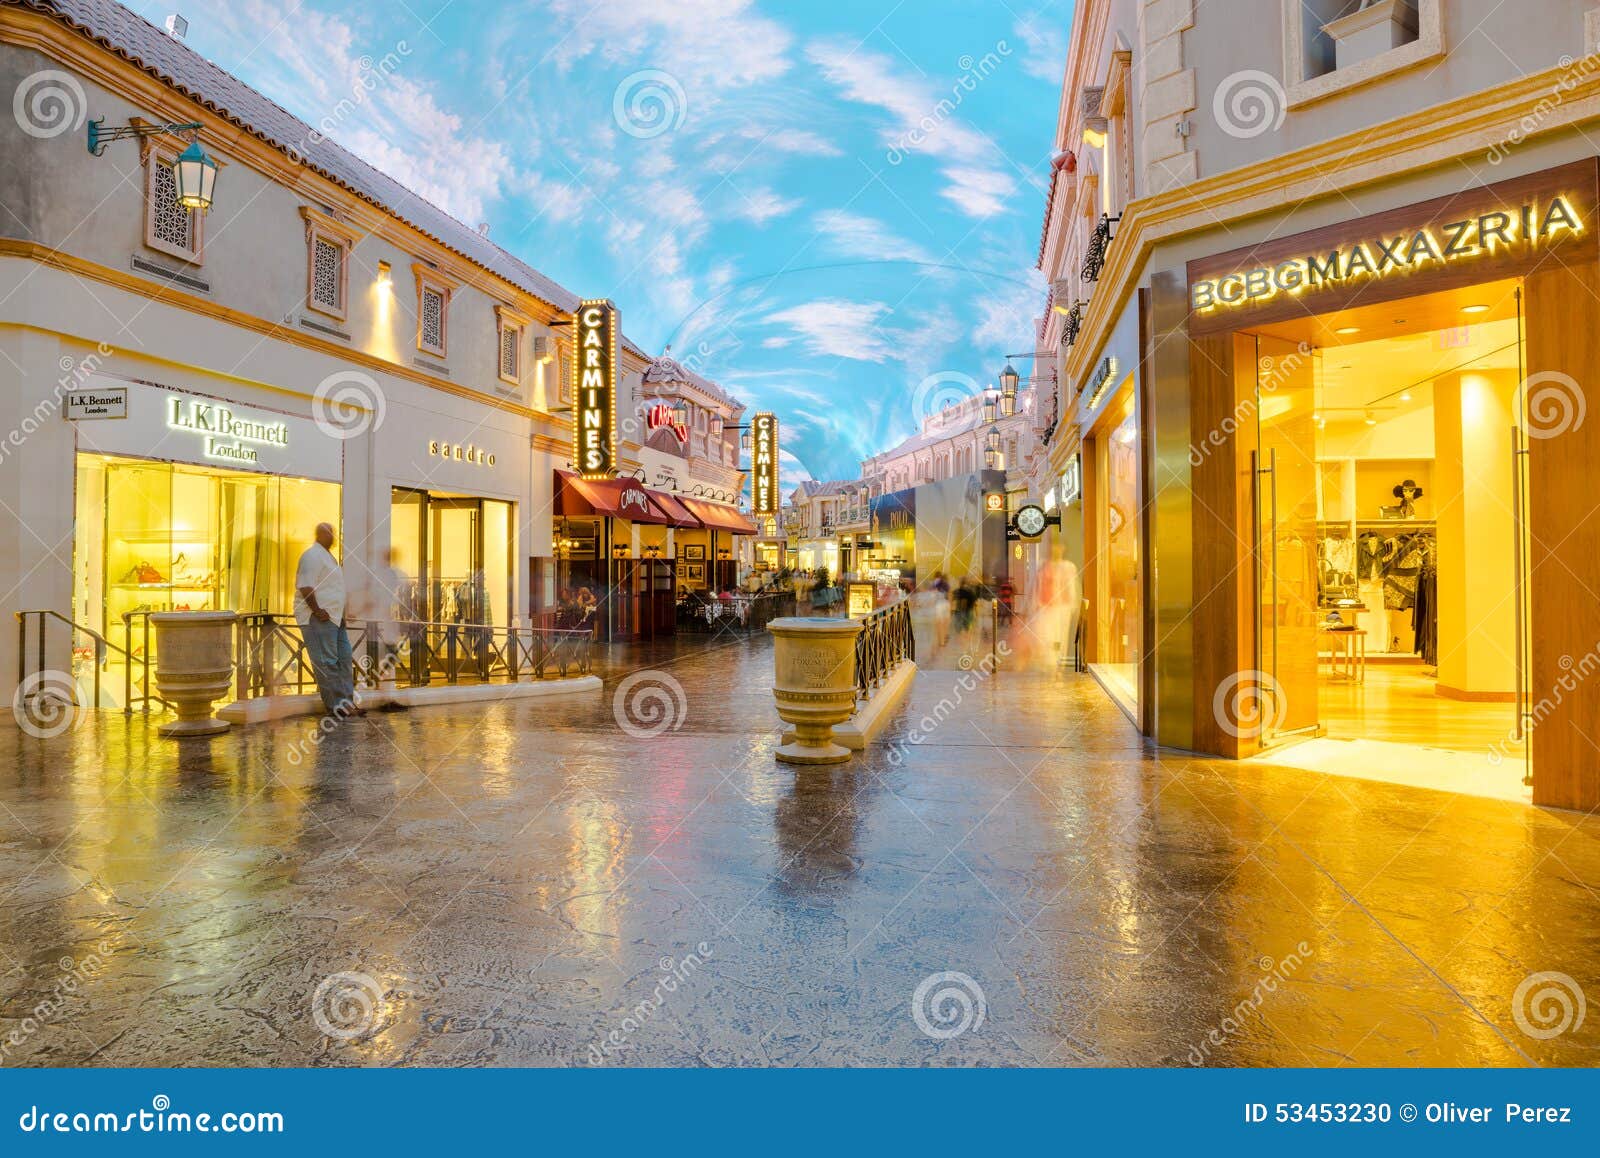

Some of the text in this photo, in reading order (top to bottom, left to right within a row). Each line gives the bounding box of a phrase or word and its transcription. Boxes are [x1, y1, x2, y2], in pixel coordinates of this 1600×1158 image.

[1192, 197, 1582, 312] BCBGMAXAZRIA
[582, 308, 605, 470] CARMINES
[204, 437, 258, 462] London
[430, 440, 496, 466] sandro
[757, 418, 772, 512] CARMINES
